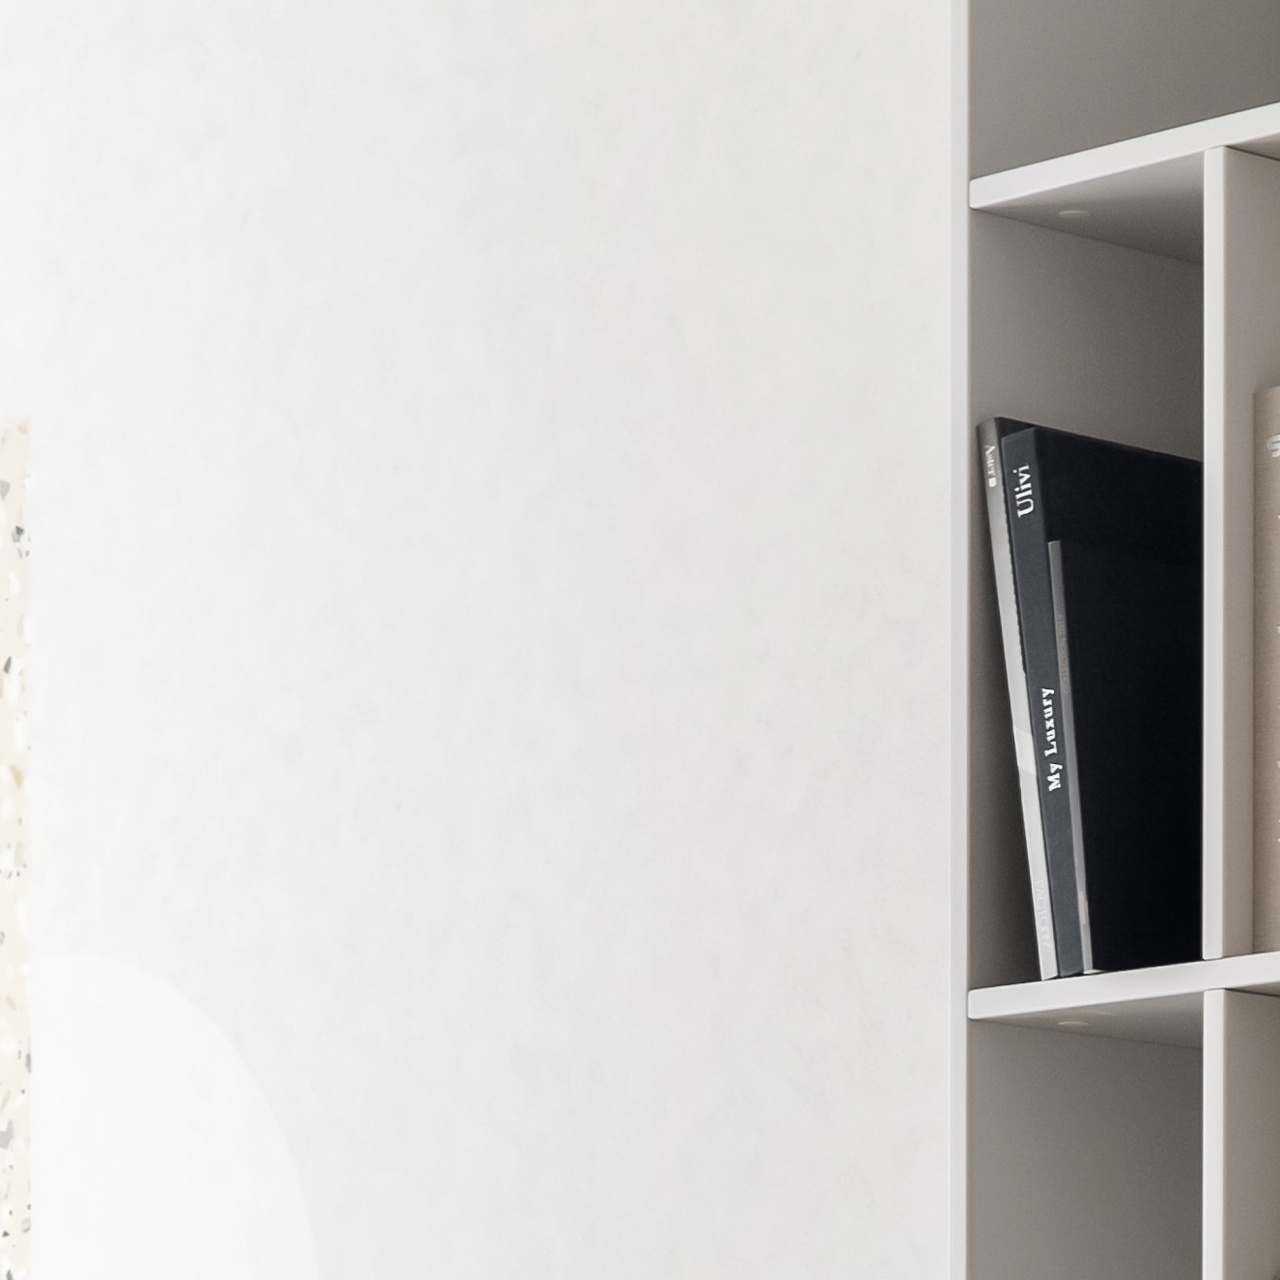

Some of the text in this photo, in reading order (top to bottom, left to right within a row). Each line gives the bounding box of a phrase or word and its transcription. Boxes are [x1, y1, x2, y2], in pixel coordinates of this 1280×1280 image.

[1013, 463, 1034, 518] Ulivi
[1041, 687, 1062, 791] My Luxury
